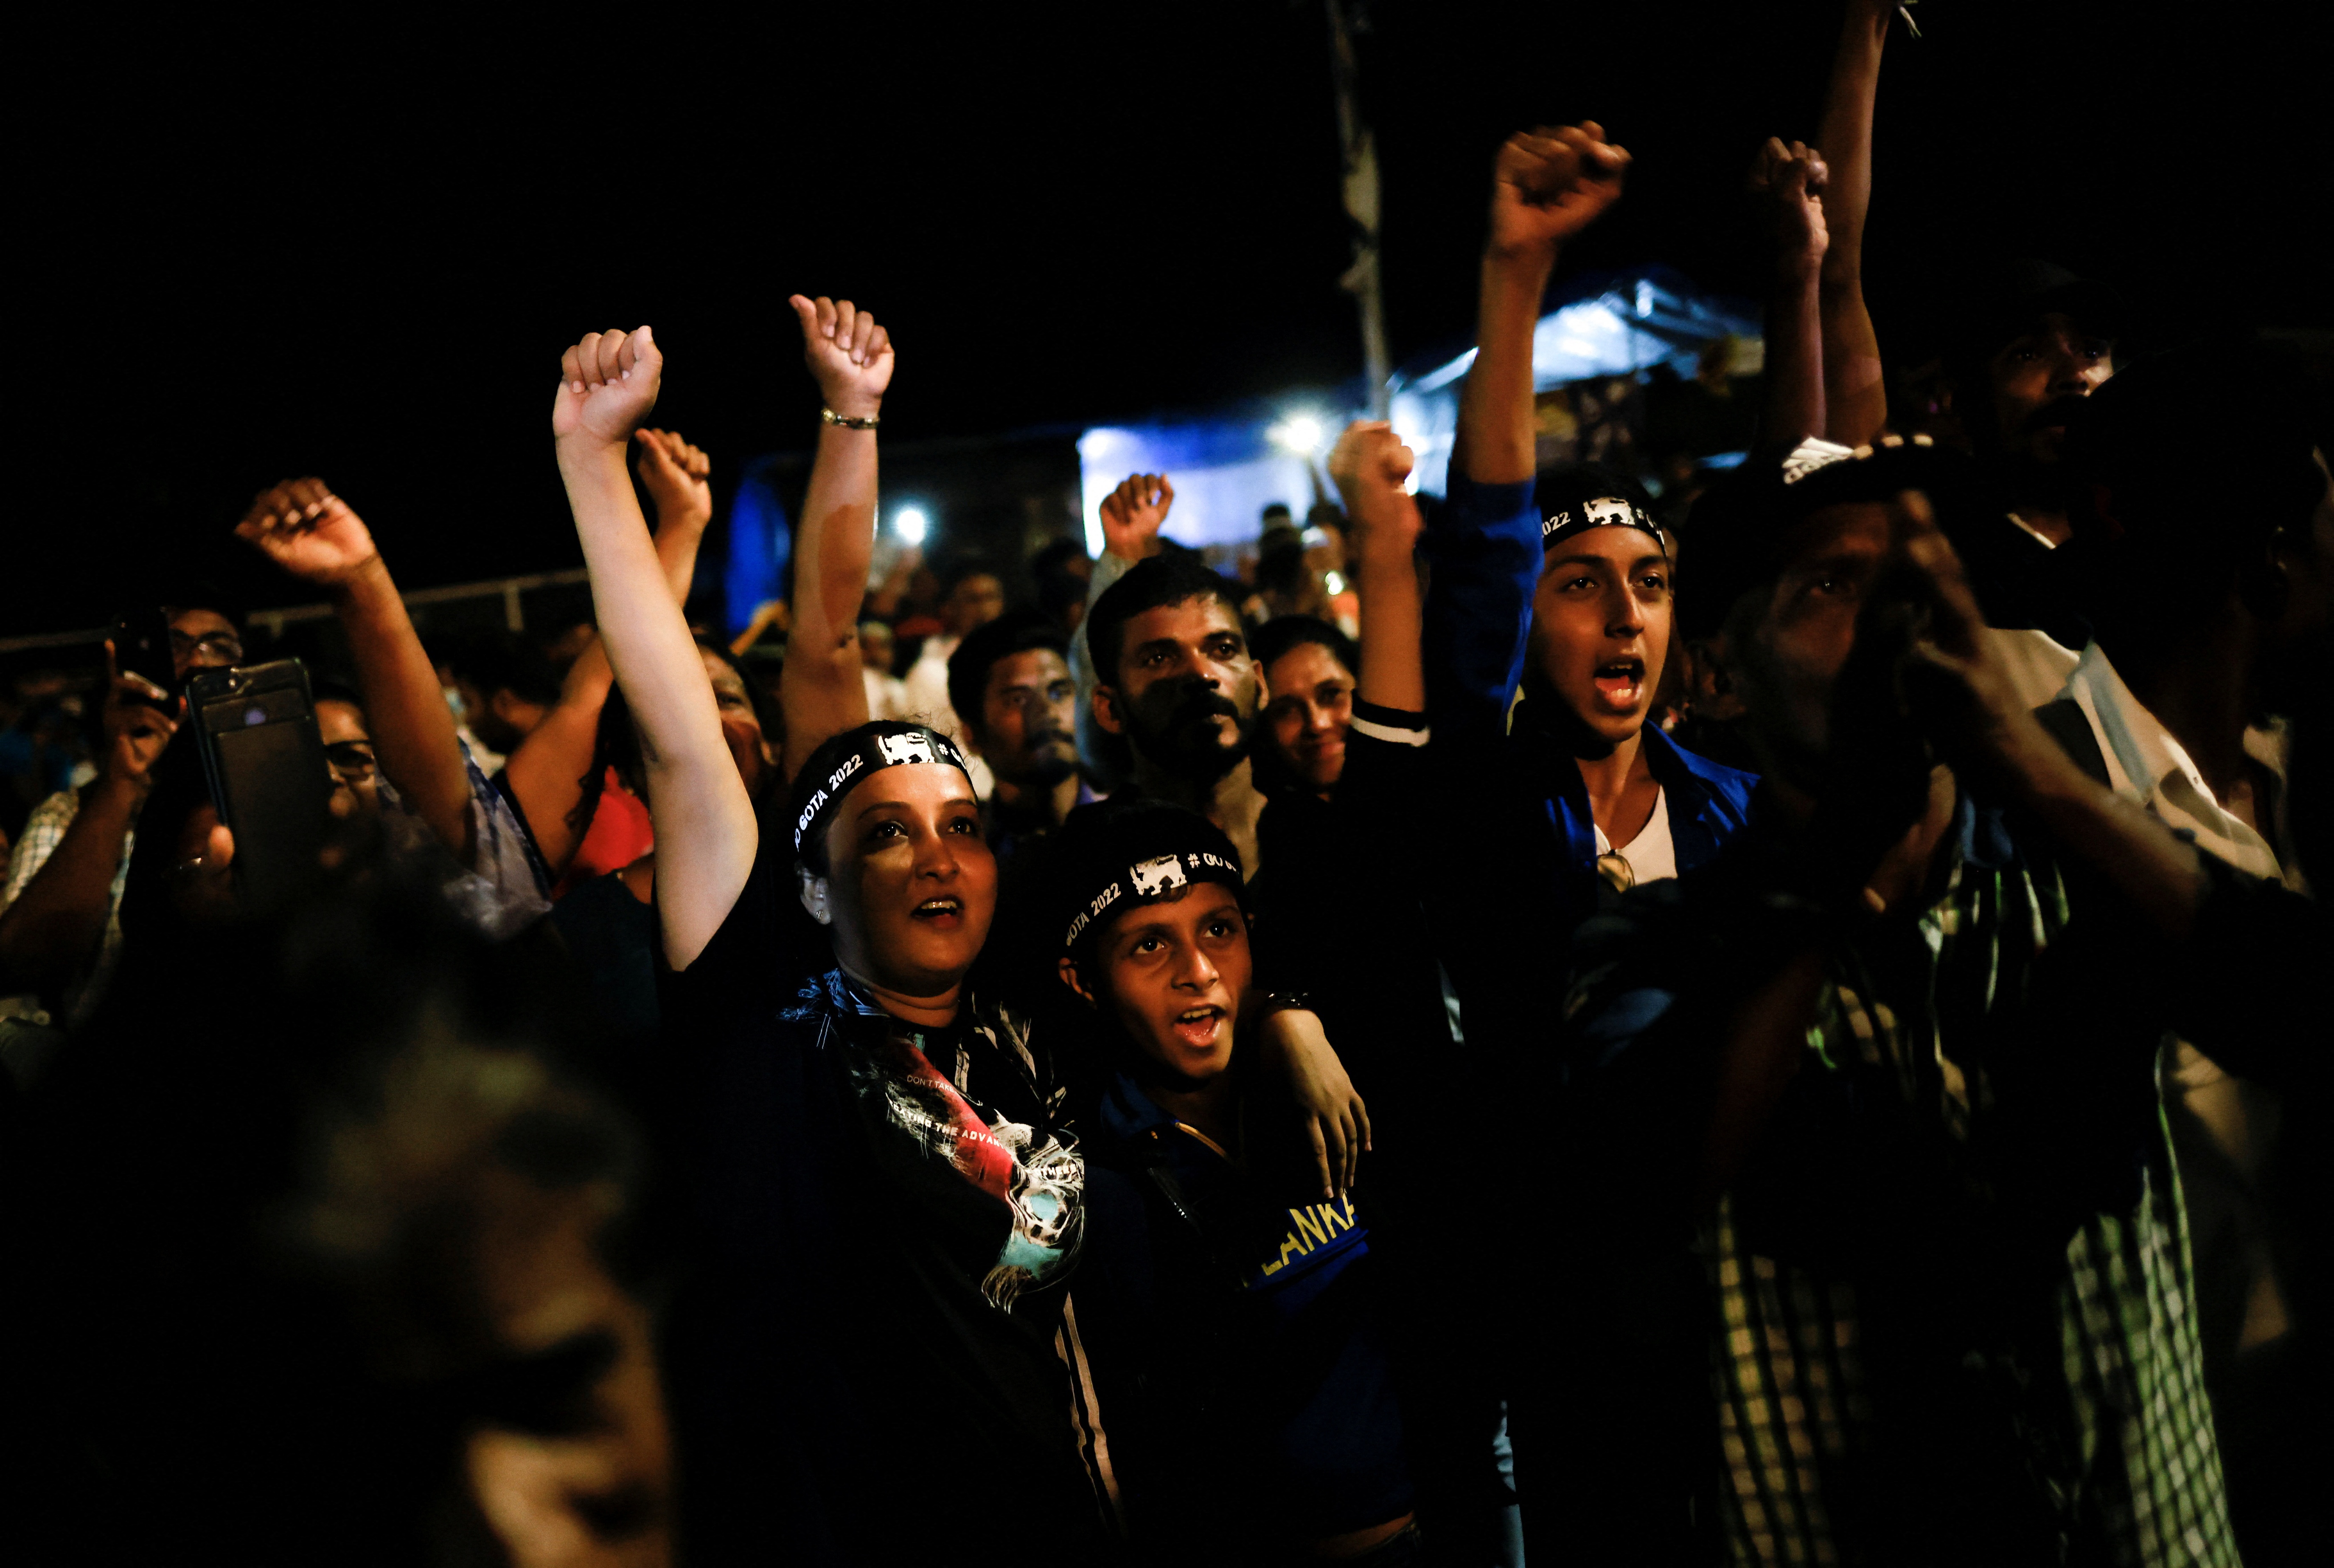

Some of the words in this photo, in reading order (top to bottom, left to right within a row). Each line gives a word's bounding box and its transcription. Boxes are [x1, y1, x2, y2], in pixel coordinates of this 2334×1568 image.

[1542, 511, 1571, 538] 022
[799, 789, 828, 831] GOTA
[829, 754, 864, 791] 2022
[1091, 882, 1121, 917] 2022
[907, 1074, 933, 1087] DON'T
[934, 1080, 956, 1093] TAKE
[935, 1122, 959, 1137] THE
